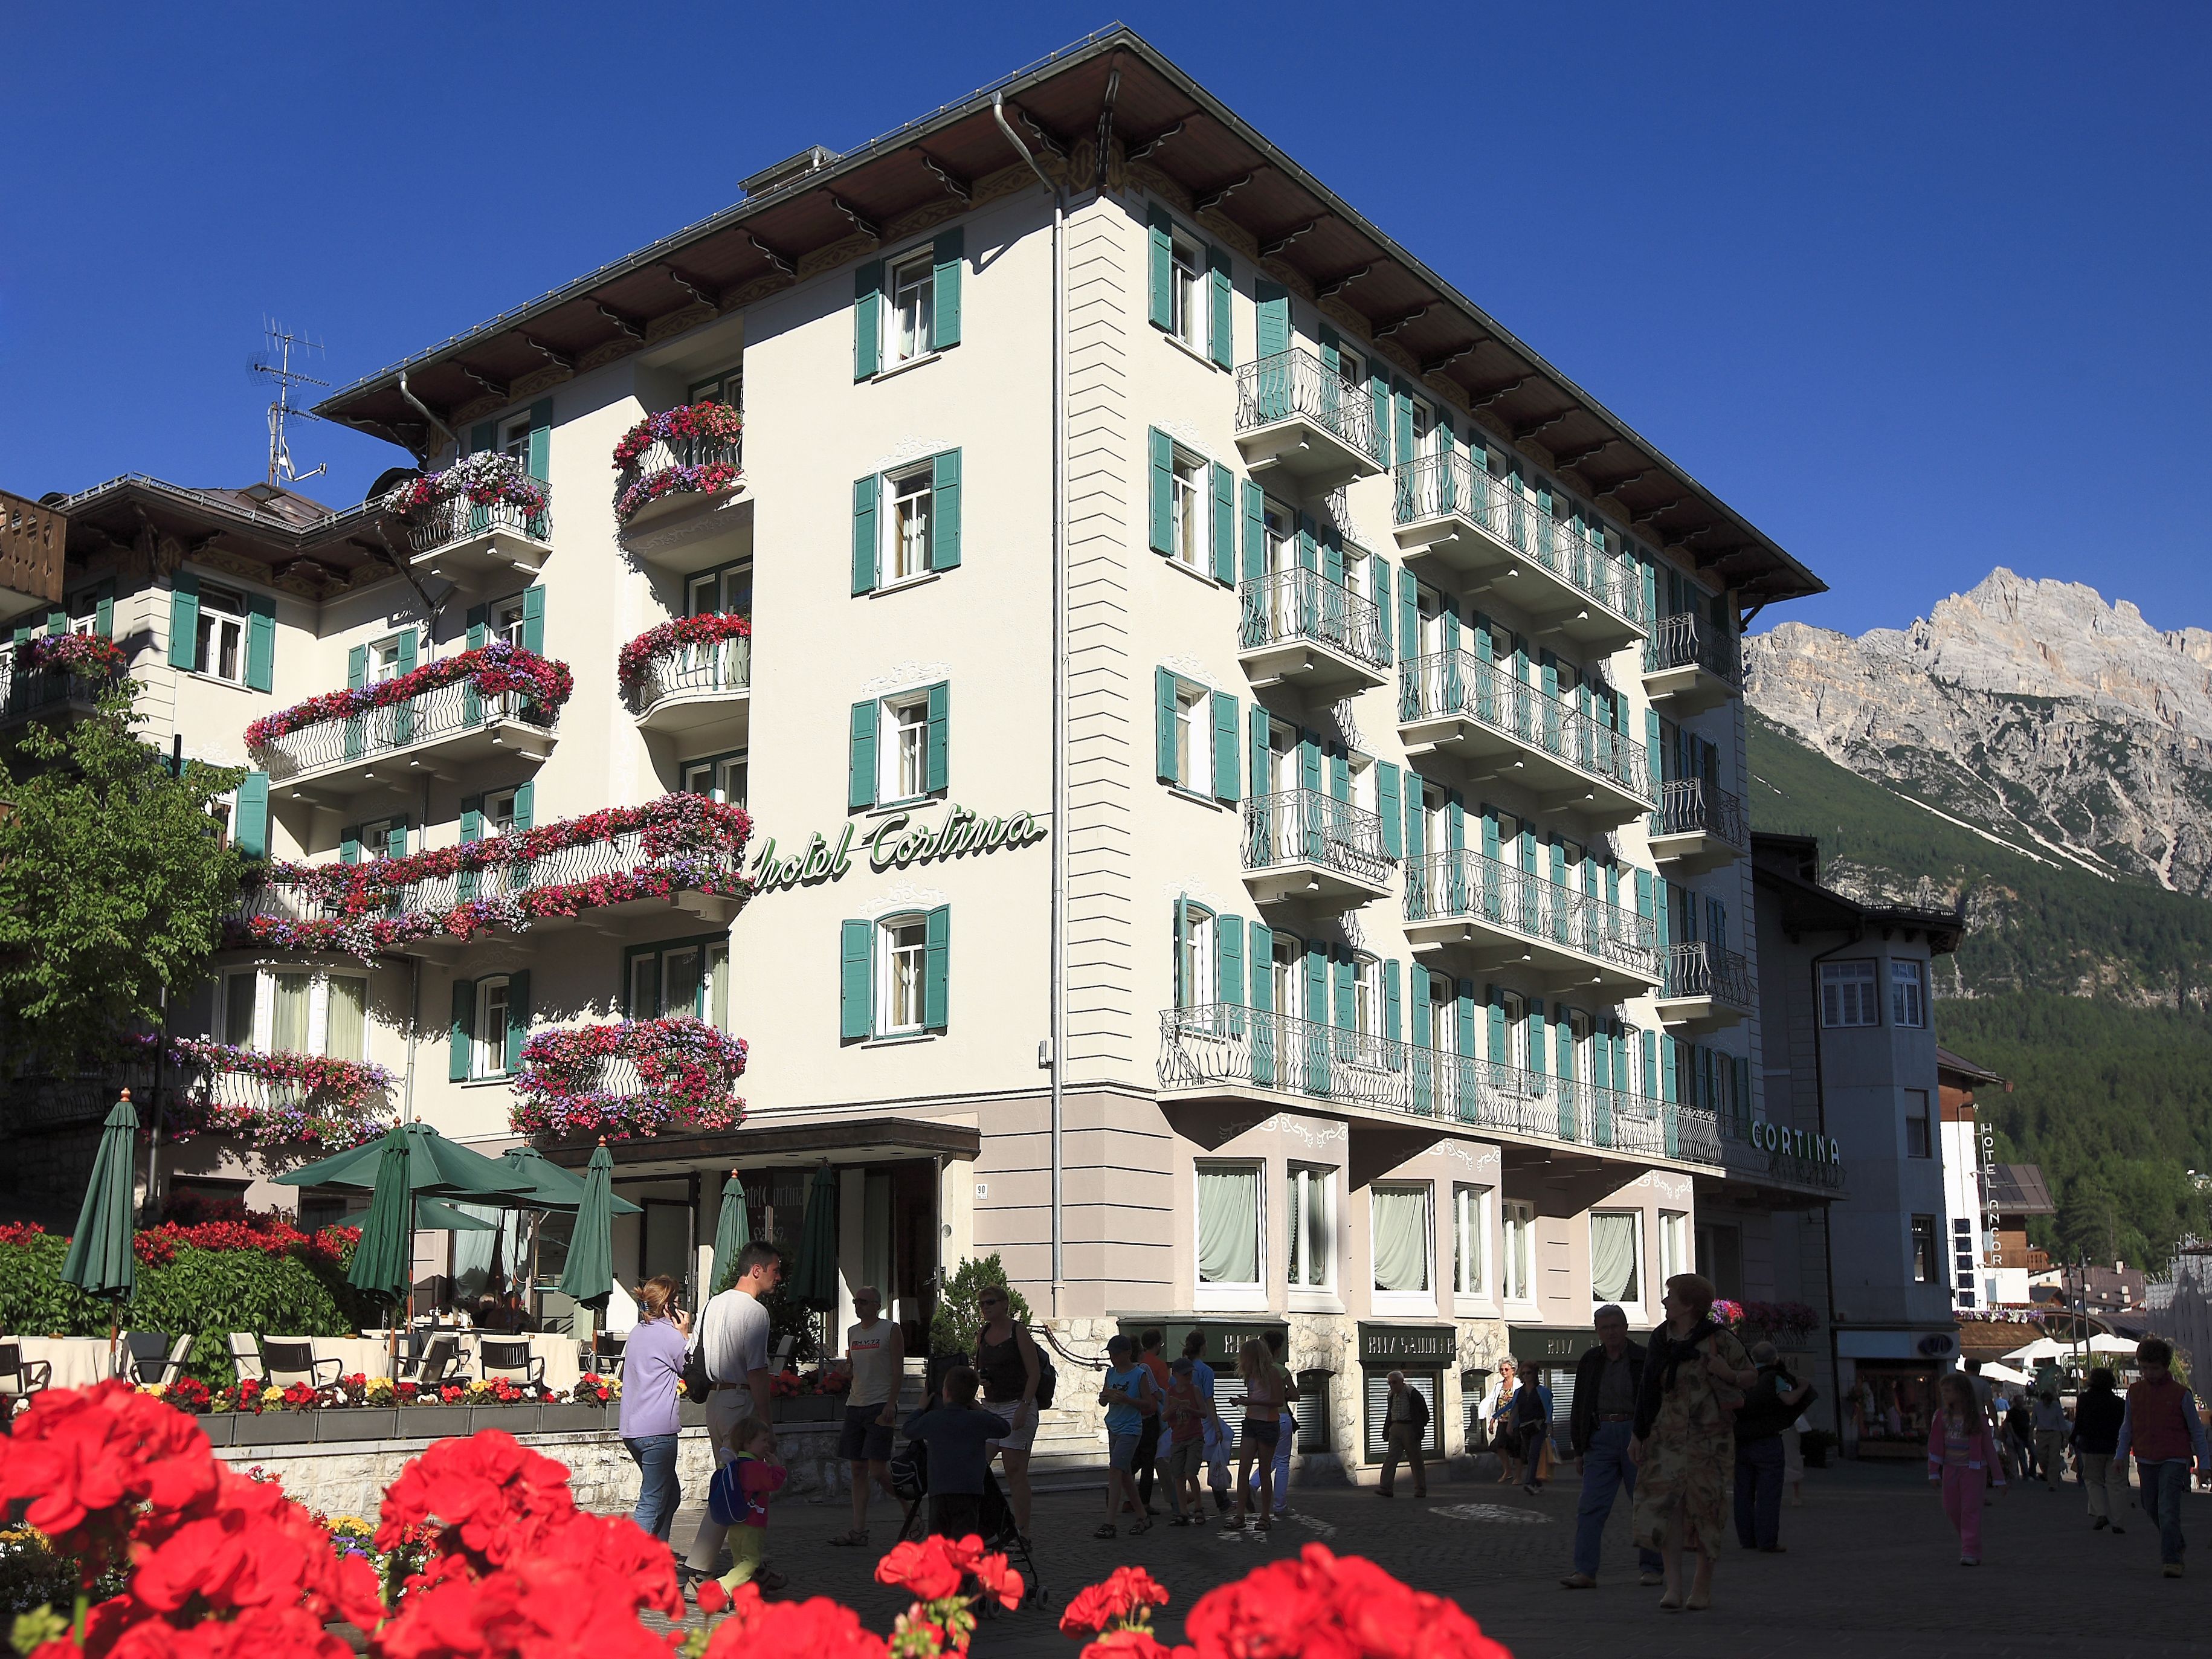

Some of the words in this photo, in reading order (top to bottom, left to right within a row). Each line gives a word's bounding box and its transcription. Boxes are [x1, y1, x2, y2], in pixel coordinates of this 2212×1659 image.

[752, 821, 853, 889] hotel
[862, 803, 1048, 868] Cortina
[1749, 1120, 1840, 1165] CORTINA
[1982, 1123, 1997, 1188] HOTEL
[978, 1185, 985, 1194] 90
[1955, 1220, 1973, 1306] SPORT
[1988, 1199, 2004, 1279] ANCORA
